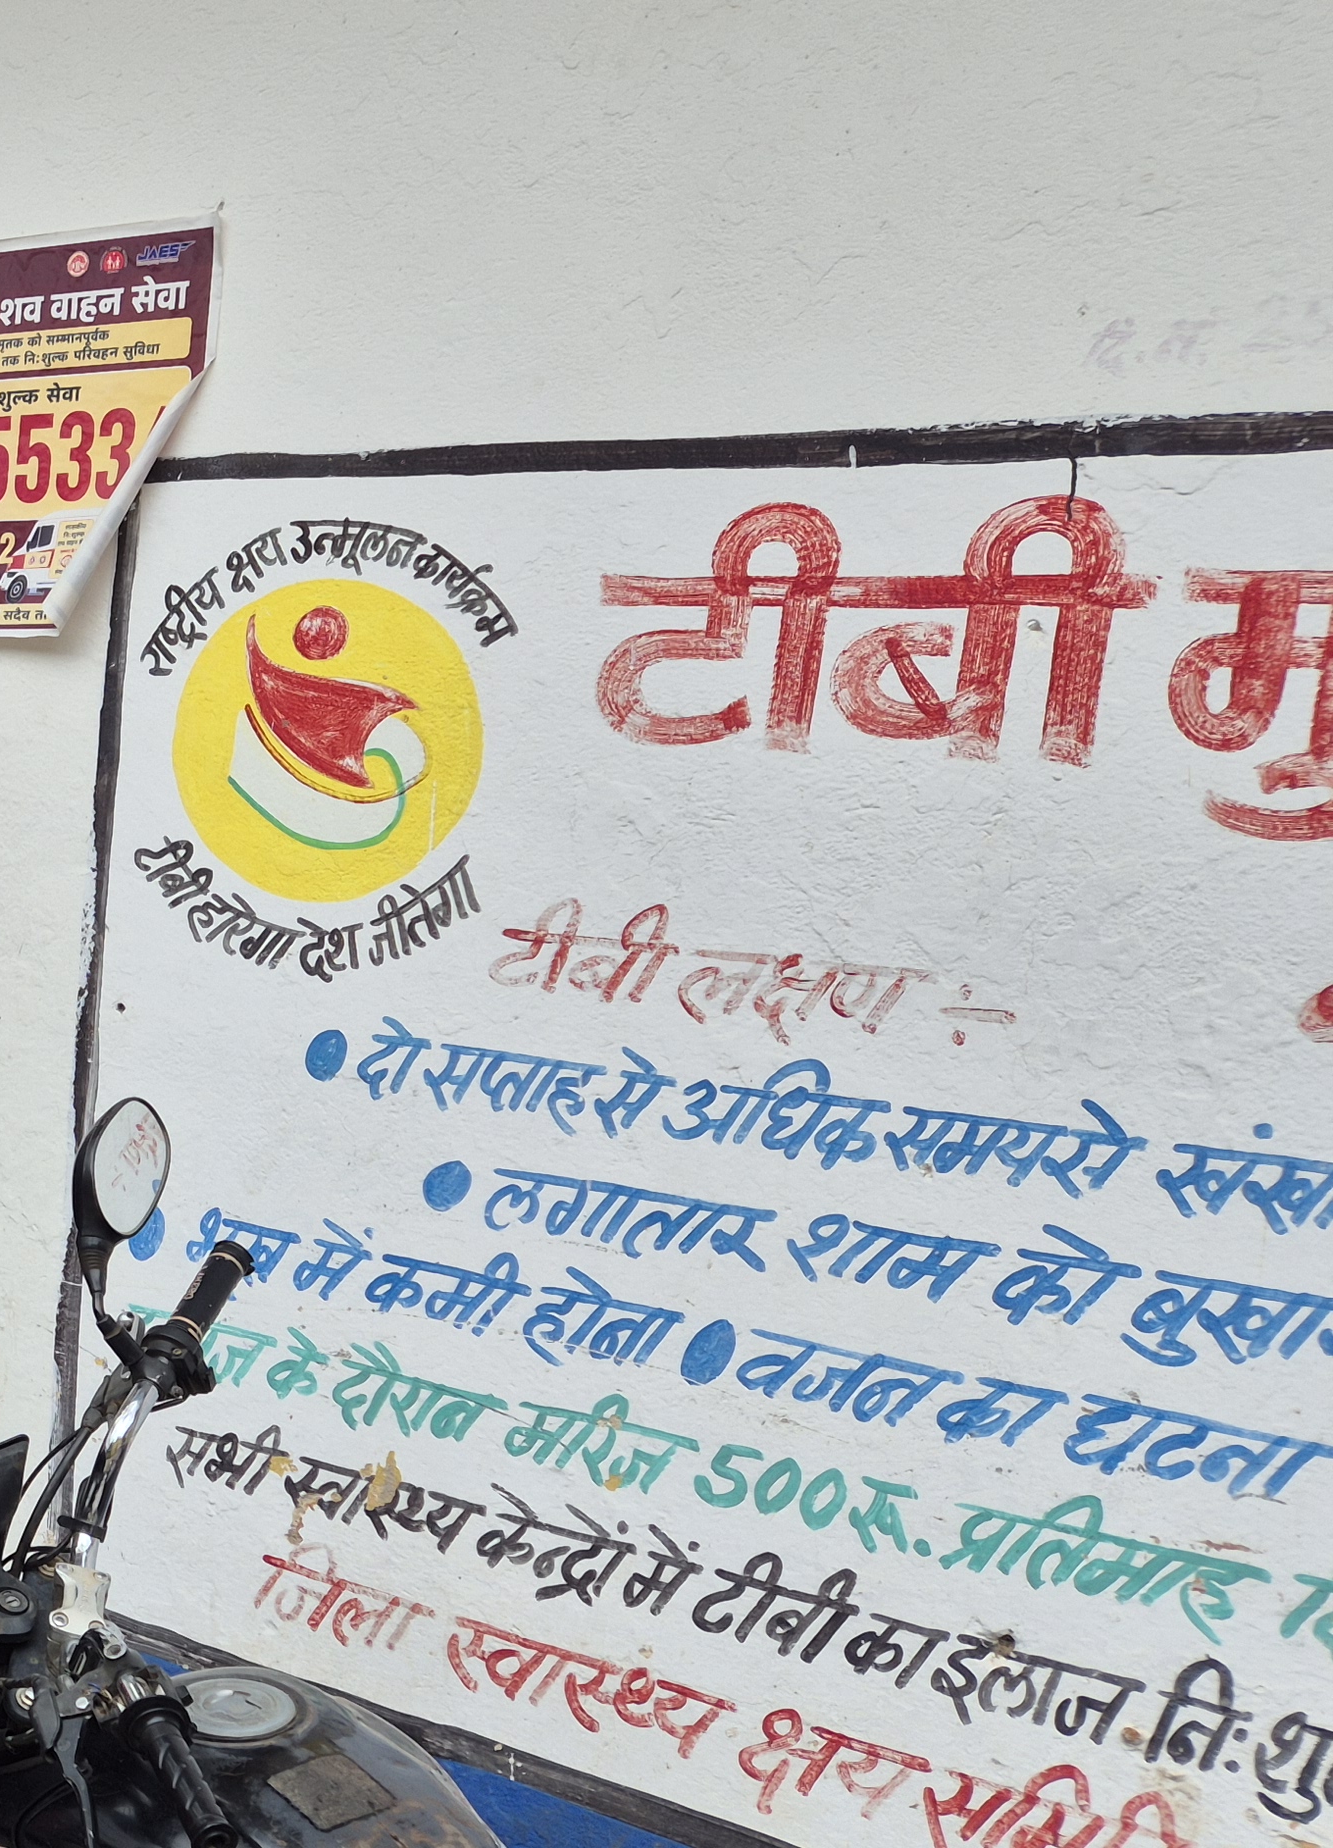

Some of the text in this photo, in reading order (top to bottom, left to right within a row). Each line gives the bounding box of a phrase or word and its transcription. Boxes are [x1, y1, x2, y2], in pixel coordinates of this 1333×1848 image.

[0, 294, 45, 326] शव
[50, 287, 124, 322] वाहन
[131, 275, 190, 314] सेवा
[2, 355, 20, 367] तक
[74, 345, 119, 362] परिवहन
[123, 341, 161, 361] सुविधा
[27, 333, 42, 347] को
[46, 328, 110, 348] सम्मानपूर्वक
[46, 382, 81, 404] सेवा
[3, 607, 30, 621] सदैव
[140, 517, 519, 677] राष्ट्रीय क्षय उन्मूलन कार्यक्रम
[596, 494, 1162, 769] टीबी
[134, 835, 482, 982] टीबी हारेगा देश जीतेगा
[487, 898, 939, 1047] टीबी लक्षण
[356, 1015, 893, 1172] दो सप्ताह से अधिक
[484, 1167, 1142, 1326] लगातार शाम को
[293, 1216, 375, 1301] में
[366, 1251, 532, 1338] कमी
[522, 1266, 686, 1368] होना
[736, 1328, 965, 1428] वजन
[936, 1376, 1070, 1447] का
[1064, 1393, 1333, 1498] घटना
[268, 1326, 330, 1400] के
[333, 1341, 511, 1442] दौरान
[939, 1494, 1272, 1646] प्रतिमाह
[166, 1424, 290, 1496] सभी
[476, 1482, 637, 1606] केन्द्रों
[624, 1524, 704, 1617] में
[692, 1552, 860, 1663] टीबी
[844, 1612, 951, 1691] का
[931, 1633, 1146, 1746] इलाज
[253, 1543, 933, 1820] जिला स्वास्थ्य क्षय
